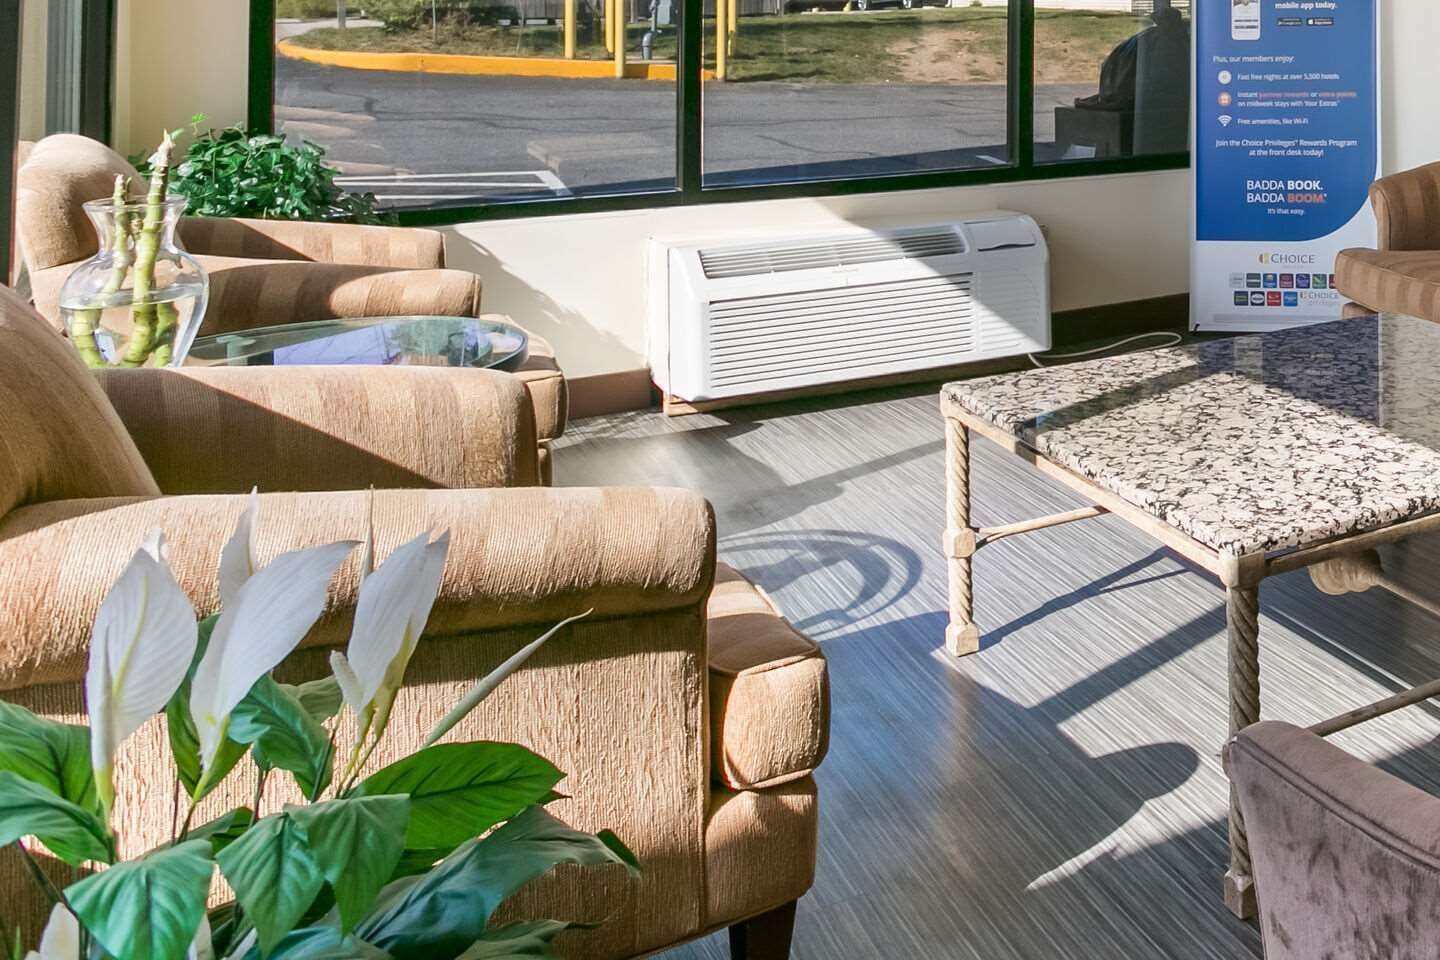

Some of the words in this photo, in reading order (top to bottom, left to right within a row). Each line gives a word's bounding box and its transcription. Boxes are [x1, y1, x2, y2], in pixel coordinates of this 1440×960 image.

[1275, 1, 1299, 9] mobile
[1300, 2, 1314, 10] app
[1242, 55, 1274, 63] members
[1241, 139, 1264, 147] Choice
[1246, 180, 1285, 190] BADDA
[1287, 180, 1324, 190] BOOK.
[1246, 193, 1285, 203] BADDA
[1270, 253, 1316, 264] CHOICE
